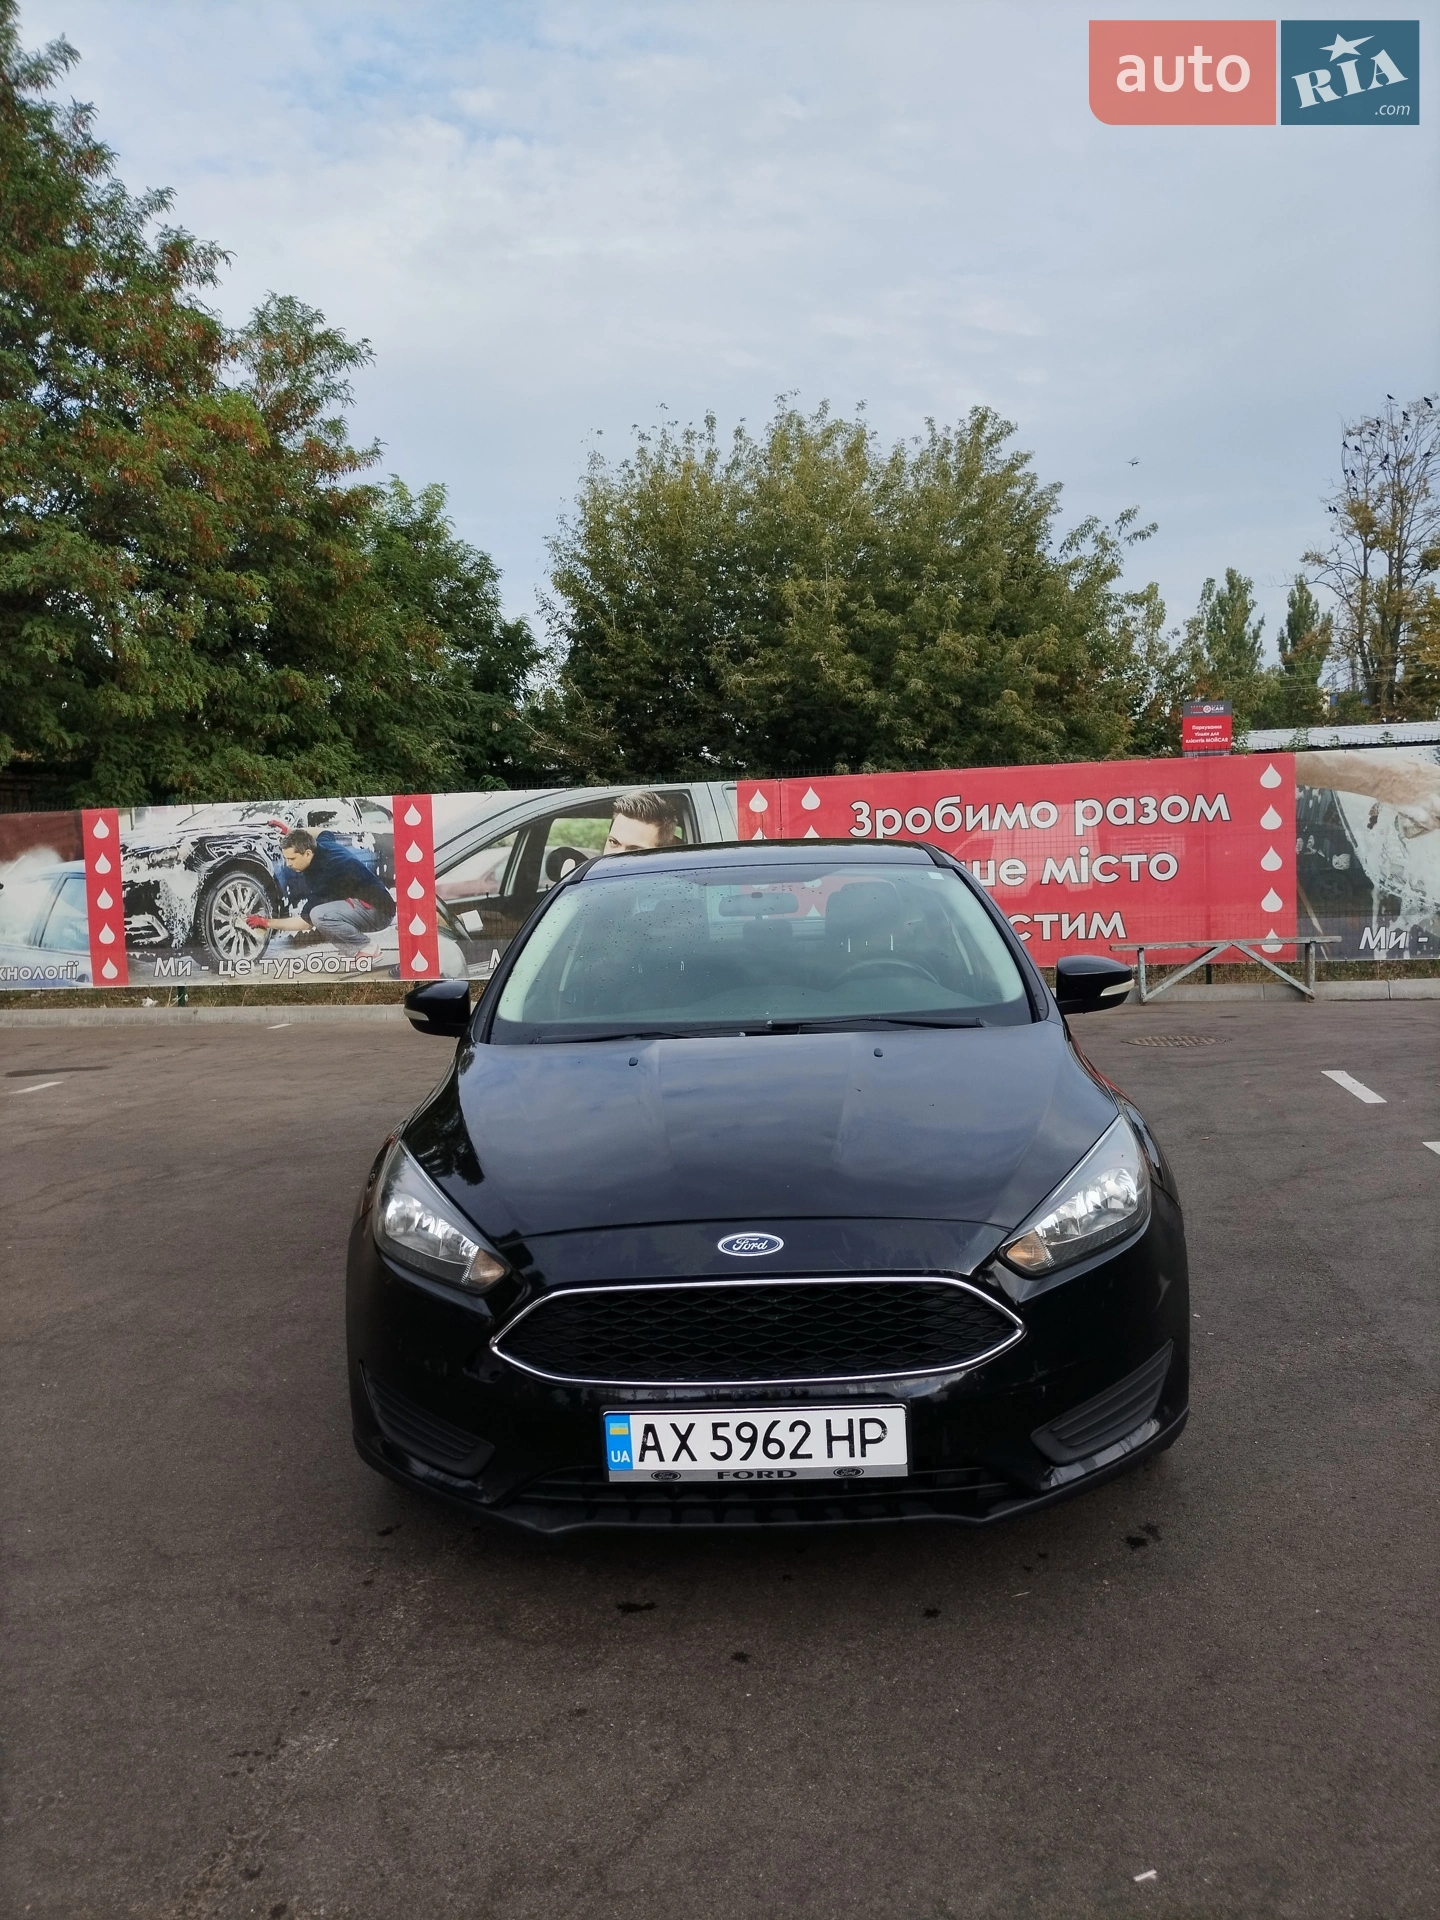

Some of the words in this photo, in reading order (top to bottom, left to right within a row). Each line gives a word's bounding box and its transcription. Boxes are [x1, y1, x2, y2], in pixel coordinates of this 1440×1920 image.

[849, 795, 1059, 839] Зробимо
[1074, 793, 1231, 836] разом
[1040, 846, 1179, 886] місто
[1358, 926, 1407, 950] Ми
[153, 956, 192, 977] Ми
[218, 957, 251, 978] це
[259, 952, 373, 979] турбота
[732, 1237, 769, 1251] Ford
[638, 1422, 698, 1463] AX
[709, 1419, 814, 1462] 5962
[825, 1417, 888, 1459] HP
[611, 1450, 631, 1462] UA
[717, 1469, 797, 1480] FORD
